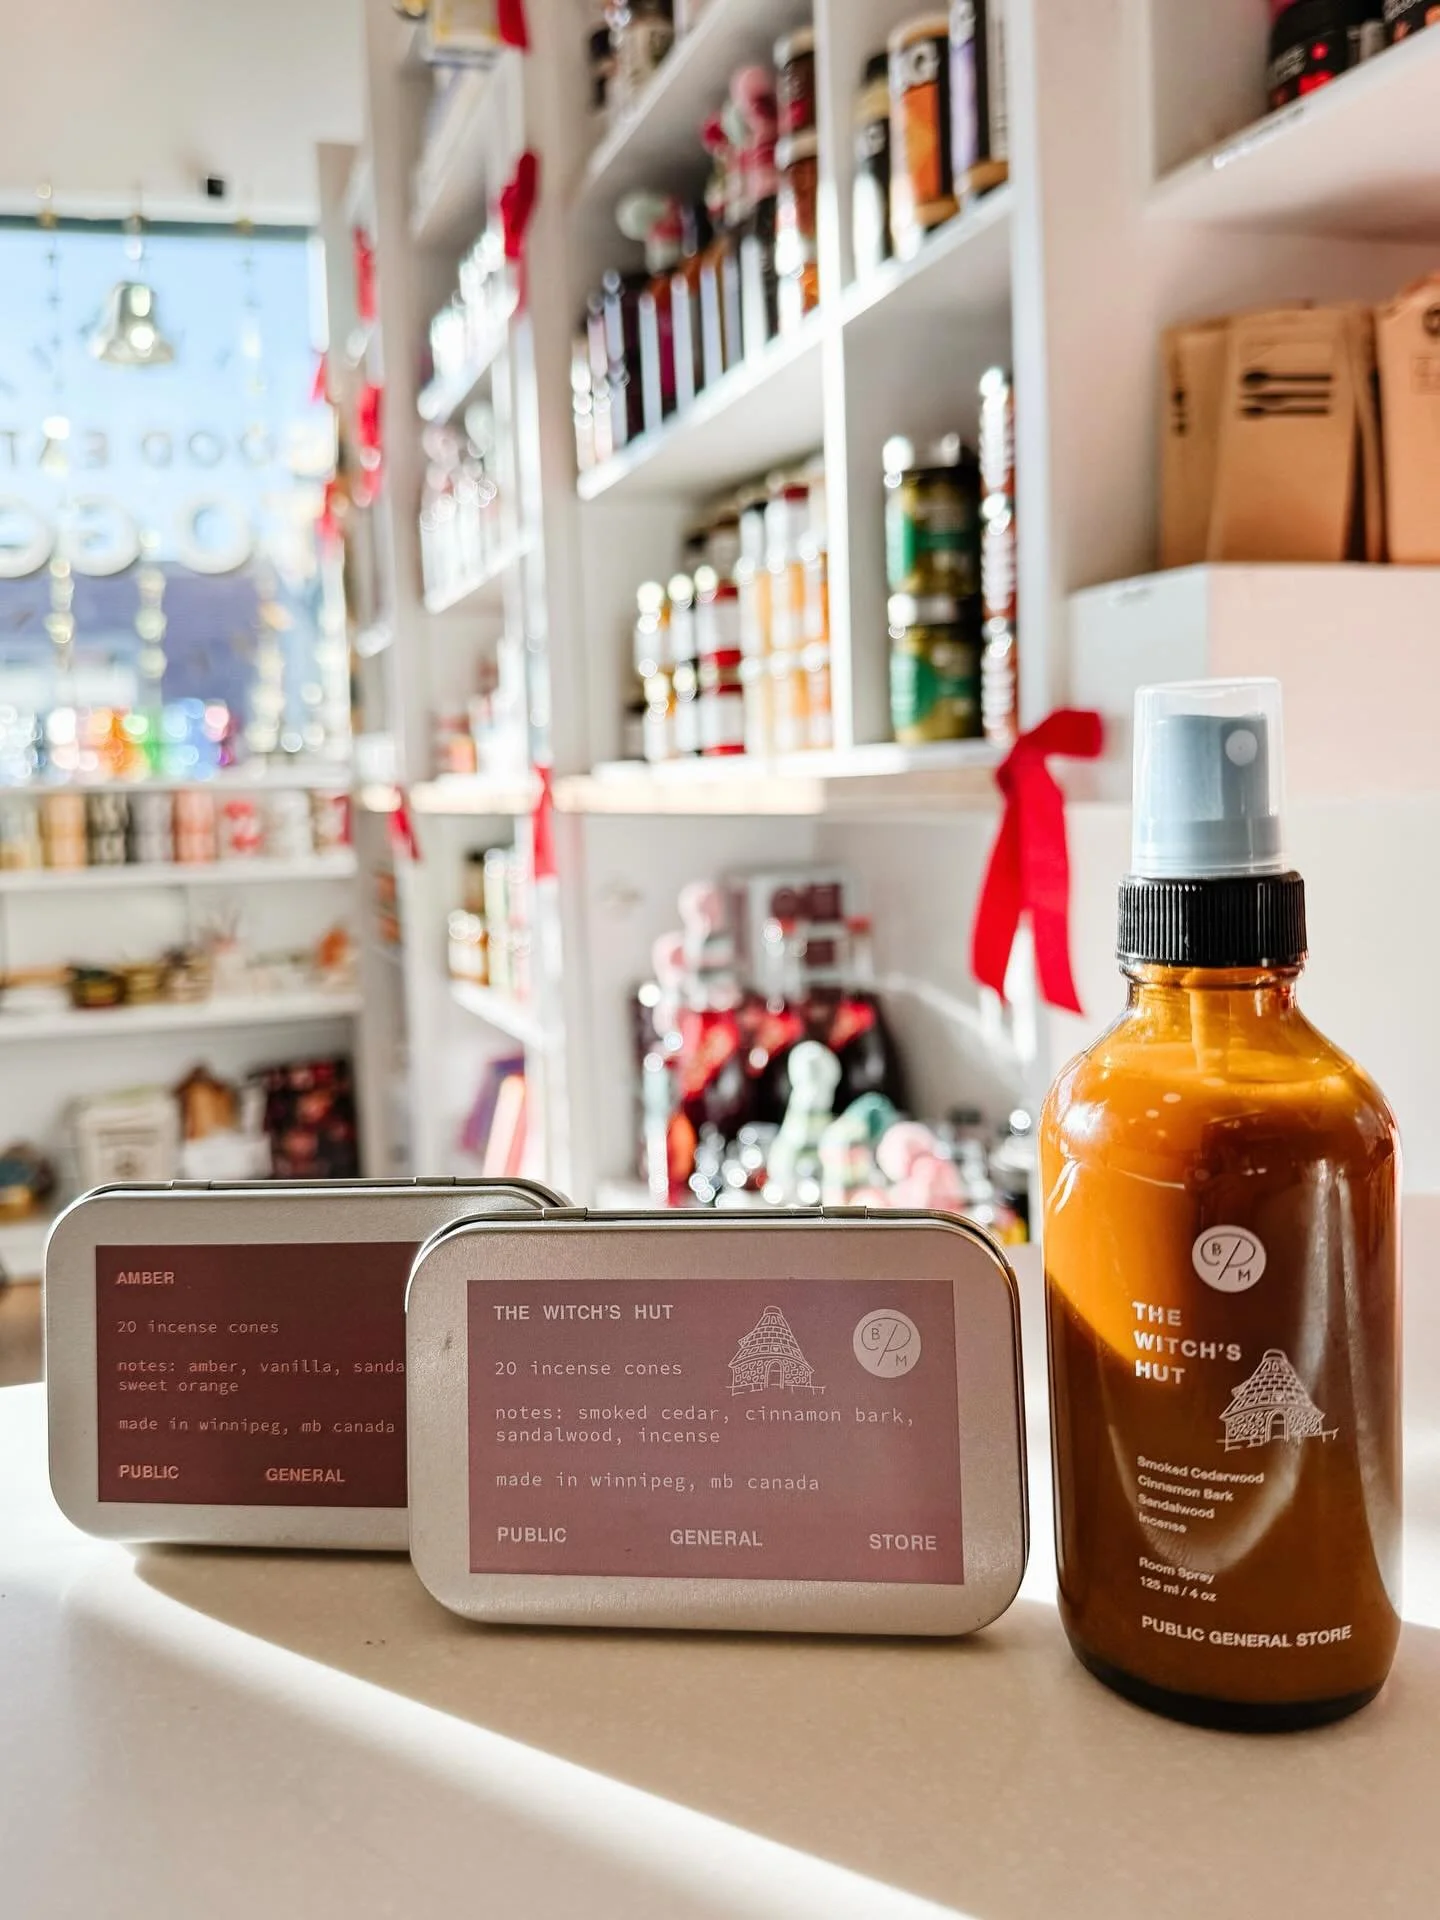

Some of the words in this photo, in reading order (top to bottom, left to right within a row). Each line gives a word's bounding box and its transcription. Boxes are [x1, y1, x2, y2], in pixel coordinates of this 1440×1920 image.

[115, 1271, 175, 1285] AMBER
[494, 1305, 529, 1320] THE
[543, 1304, 621, 1320] WITCH'S
[635, 1304, 673, 1320] HUT
[1132, 1300, 1182, 1326] THE
[117, 1320, 137, 1334] 20
[148, 1320, 217, 1334] incense
[229, 1321, 280, 1334] cones
[1133, 1330, 1242, 1361] WITCH'S
[117, 1360, 176, 1374] notes:
[189, 1360, 248, 1376] amber,
[260, 1360, 342, 1376] vanilla,
[354, 1360, 405, 1374] sanda
[495, 1362, 517, 1376] 20
[531, 1361, 610, 1376] incense
[625, 1363, 682, 1376] cones
[1135, 1359, 1186, 1385] HUT
[119, 1380, 167, 1392] sweet
[178, 1380, 239, 1395] orange
[495, 1405, 564, 1420] notes:
[578, 1405, 647, 1421] smoked
[661, 1406, 730, 1424] cedar,
[745, 1406, 842, 1422] cinnamon
[855, 1407, 914, 1426] bark,
[119, 1418, 158, 1431] made
[169, 1418, 189, 1432] in
[199, 1418, 289, 1435] winnipeg,
[301, 1420, 322, 1433] mb
[333, 1420, 395, 1434] canada
[495, 1427, 623, 1445] sandalwood,
[638, 1428, 720, 1444] incense
[119, 1465, 179, 1480] PUBLIC
[265, 1468, 345, 1483] GENERAL
[1137, 1455, 1188, 1477] Smoked
[1190, 1467, 1265, 1484] Cedarwood
[495, 1473, 543, 1488] made
[556, 1473, 578, 1488] in
[590, 1473, 696, 1493] winnipeg,
[710, 1474, 734, 1490] mb
[747, 1475, 819, 1491] canada
[1137, 1475, 1201, 1498] Cinnamon
[1203, 1488, 1234, 1502] Bark
[1138, 1493, 1215, 1519] Sandalwood
[1138, 1512, 1187, 1534] Incense
[497, 1527, 567, 1543] PUBLIC
[670, 1529, 763, 1547] GENERAL
[869, 1534, 937, 1551] STORE
[1138, 1557, 1176, 1576] Room
[1177, 1566, 1216, 1585] Spray
[1140, 1576, 1161, 1590] 125
[1163, 1583, 1179, 1595] ml
[1189, 1589, 1198, 1599] 4
[1200, 1591, 1217, 1603] oz
[1141, 1614, 1205, 1643] PUBLIC
[1208, 1629, 1292, 1649] GENERAL
[1296, 1623, 1353, 1647] STORE
